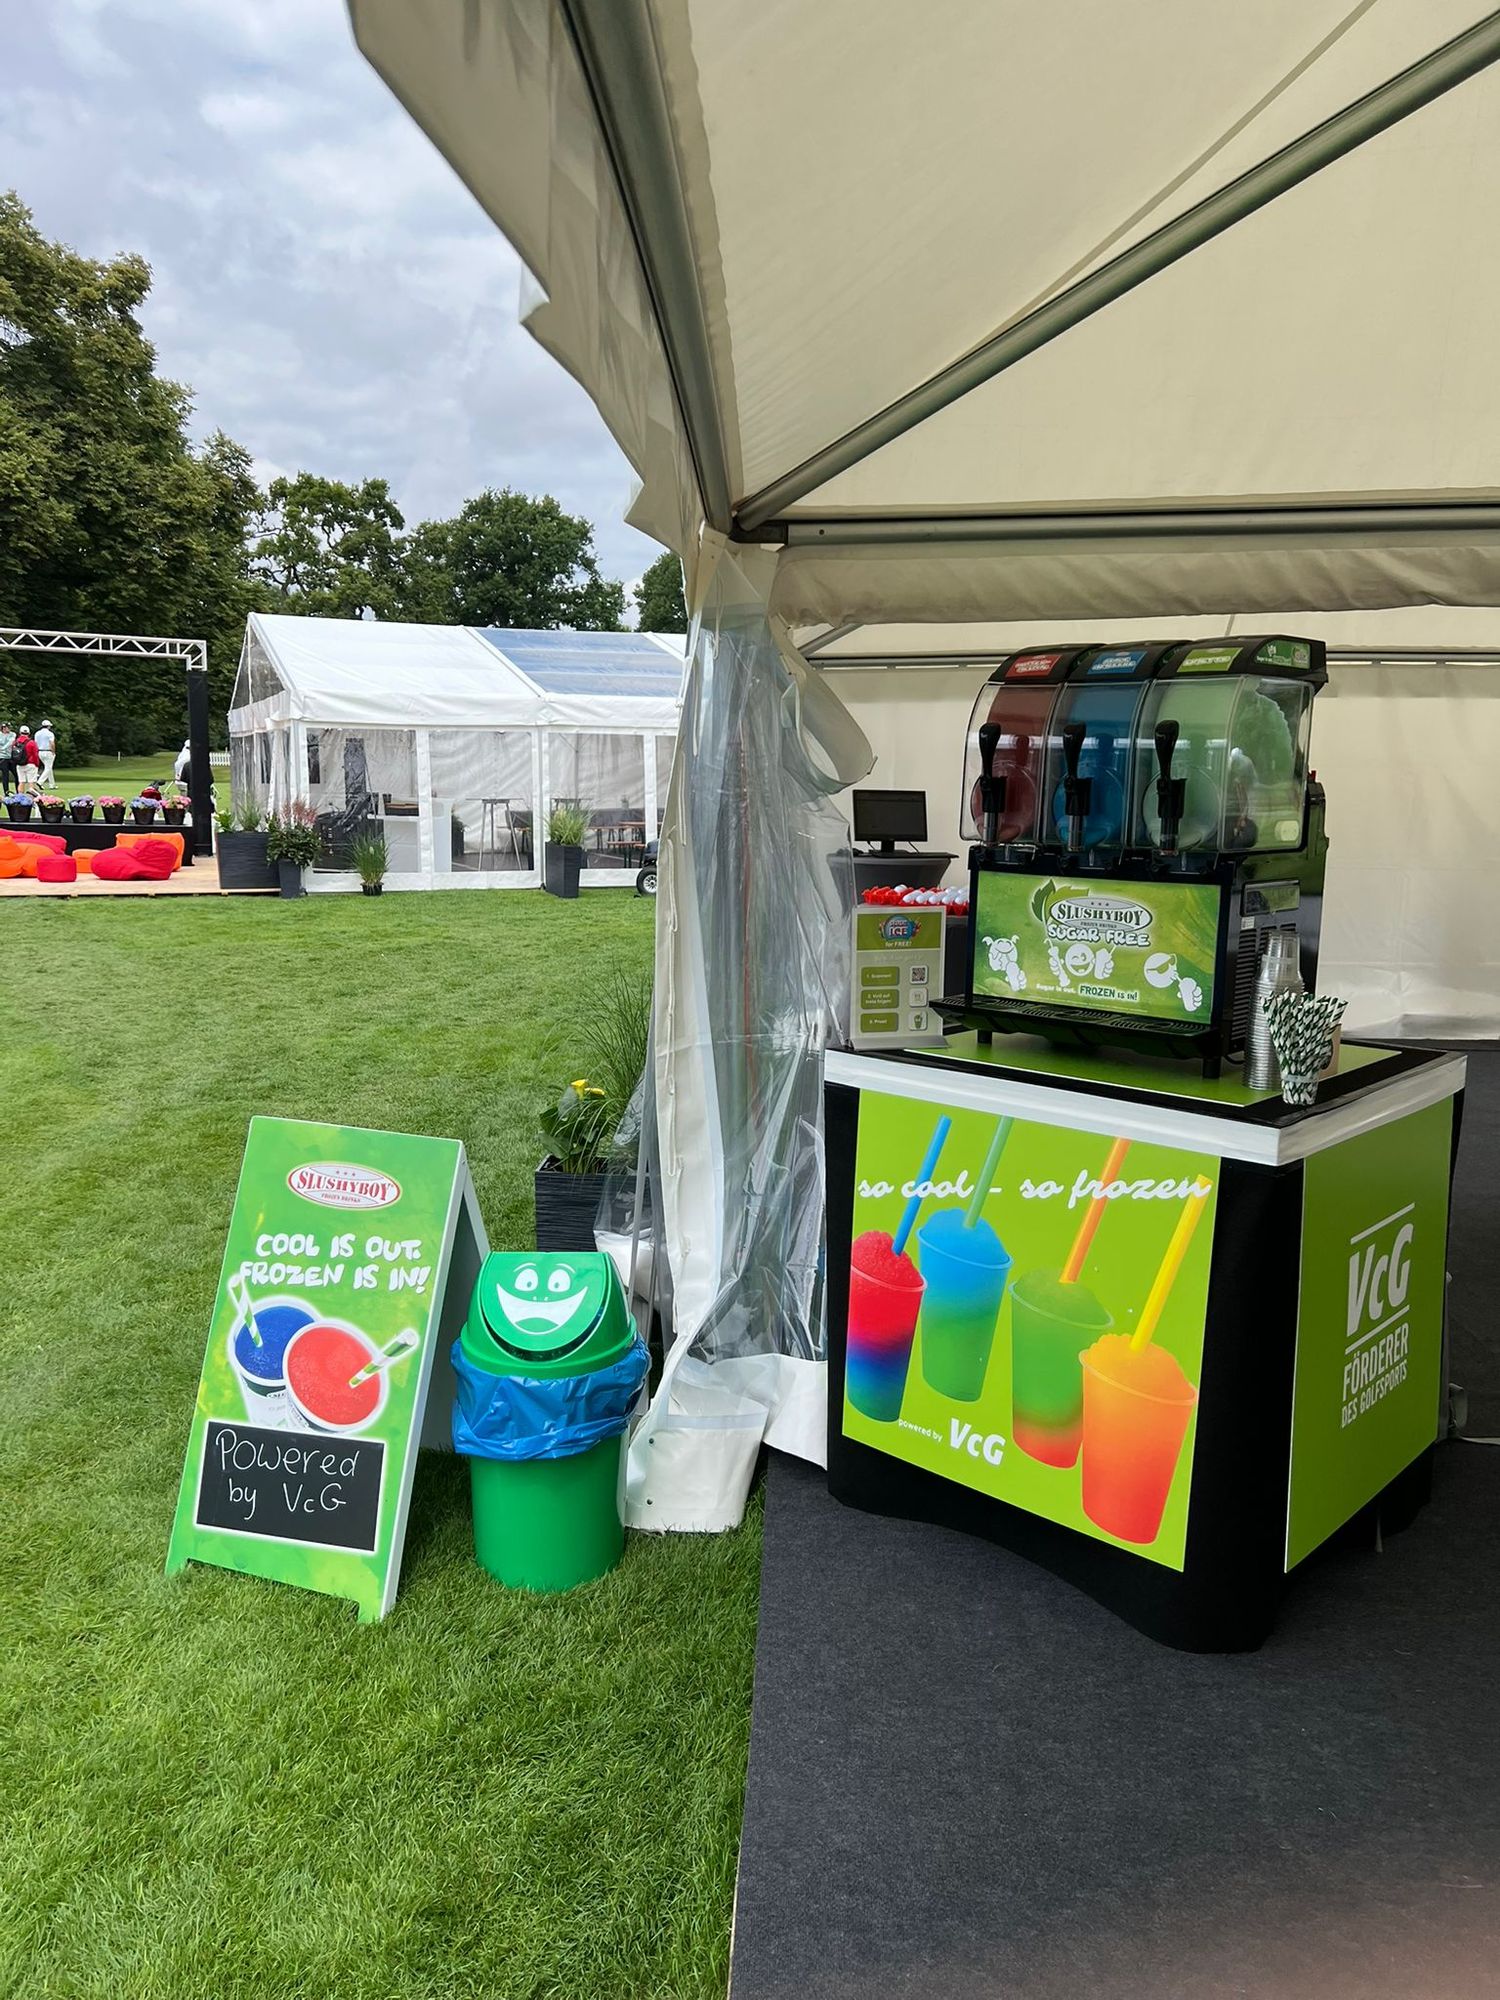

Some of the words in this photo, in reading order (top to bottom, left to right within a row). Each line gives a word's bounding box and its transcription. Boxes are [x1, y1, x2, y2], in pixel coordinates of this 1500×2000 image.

[1048, 923, 1100, 943] SUGAR
[1105, 929, 1151, 946] FREE
[1057, 903, 1143, 926] SLUSHYBOY
[1080, 985, 1116, 998] FROZEN
[297, 1170, 391, 1201] SLUSHYBOY
[858, 1179, 894, 1199] so
[901, 1170, 975, 1199] cool
[1019, 1178, 1064, 1199] so
[1067, 1169, 1212, 1209] frozen
[255, 1233, 320, 1257] COOL
[330, 1233, 356, 1258] IS
[365, 1236, 422, 1261] OUT.
[239, 1261, 345, 1287] FROZEN
[353, 1264, 380, 1290] IS
[388, 1266, 431, 1294] IN!
[1346, 1222, 1414, 1338] VcG
[1342, 1322, 1409, 1402] FÖRDERER
[1341, 1399, 1358, 1429] DES
[1359, 1359, 1408, 1414] GOLFSPORTS
[215, 1428, 360, 1477] Powered
[898, 1418, 931, 1438] powered
[932, 1430, 943, 1443] by
[950, 1417, 1006, 1466] VcG
[228, 1477, 257, 1520] by
[282, 1482, 347, 1513] VcG
